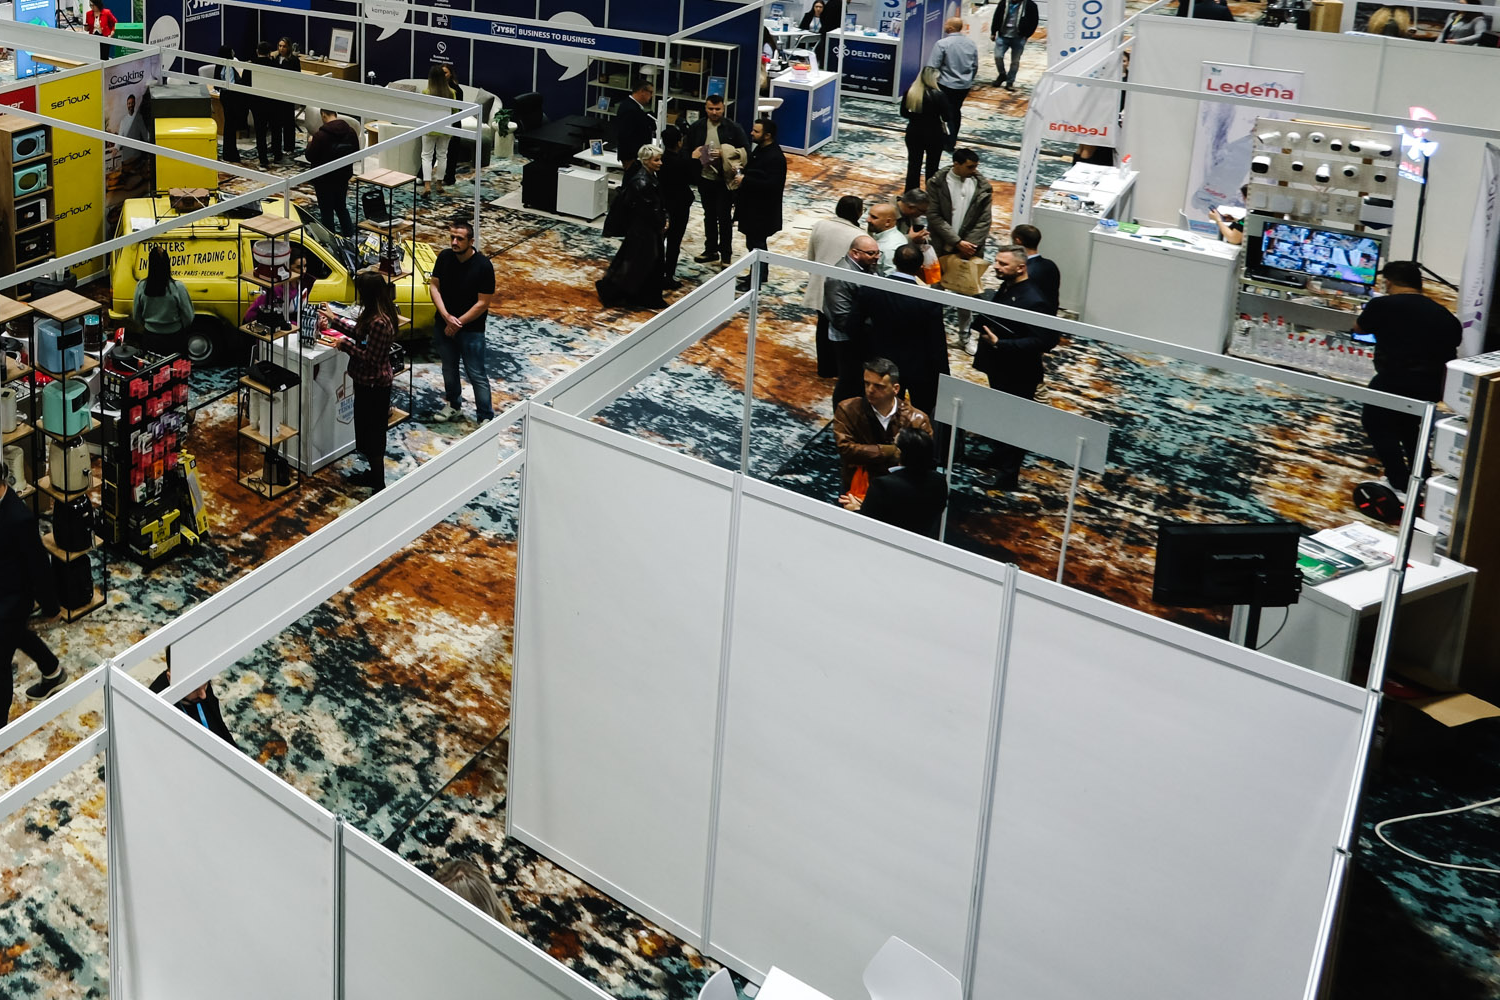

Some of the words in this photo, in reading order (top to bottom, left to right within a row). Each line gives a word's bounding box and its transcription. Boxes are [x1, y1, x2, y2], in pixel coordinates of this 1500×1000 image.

[496, 26, 516, 35] JYSK
[518, 28, 550, 39] BUSINESS
[562, 35, 596, 45] BUSINESS
[850, 50, 891, 61] DELTRON
[110, 70, 145, 85] Cooking
[1206, 78, 1295, 101] Ledena
[51, 93, 90, 110] serioux
[54, 148, 91, 166] serioux
[55, 202, 92, 221] serioux
[194, 251, 225, 265] TRADING
[228, 249, 237, 262] Co
